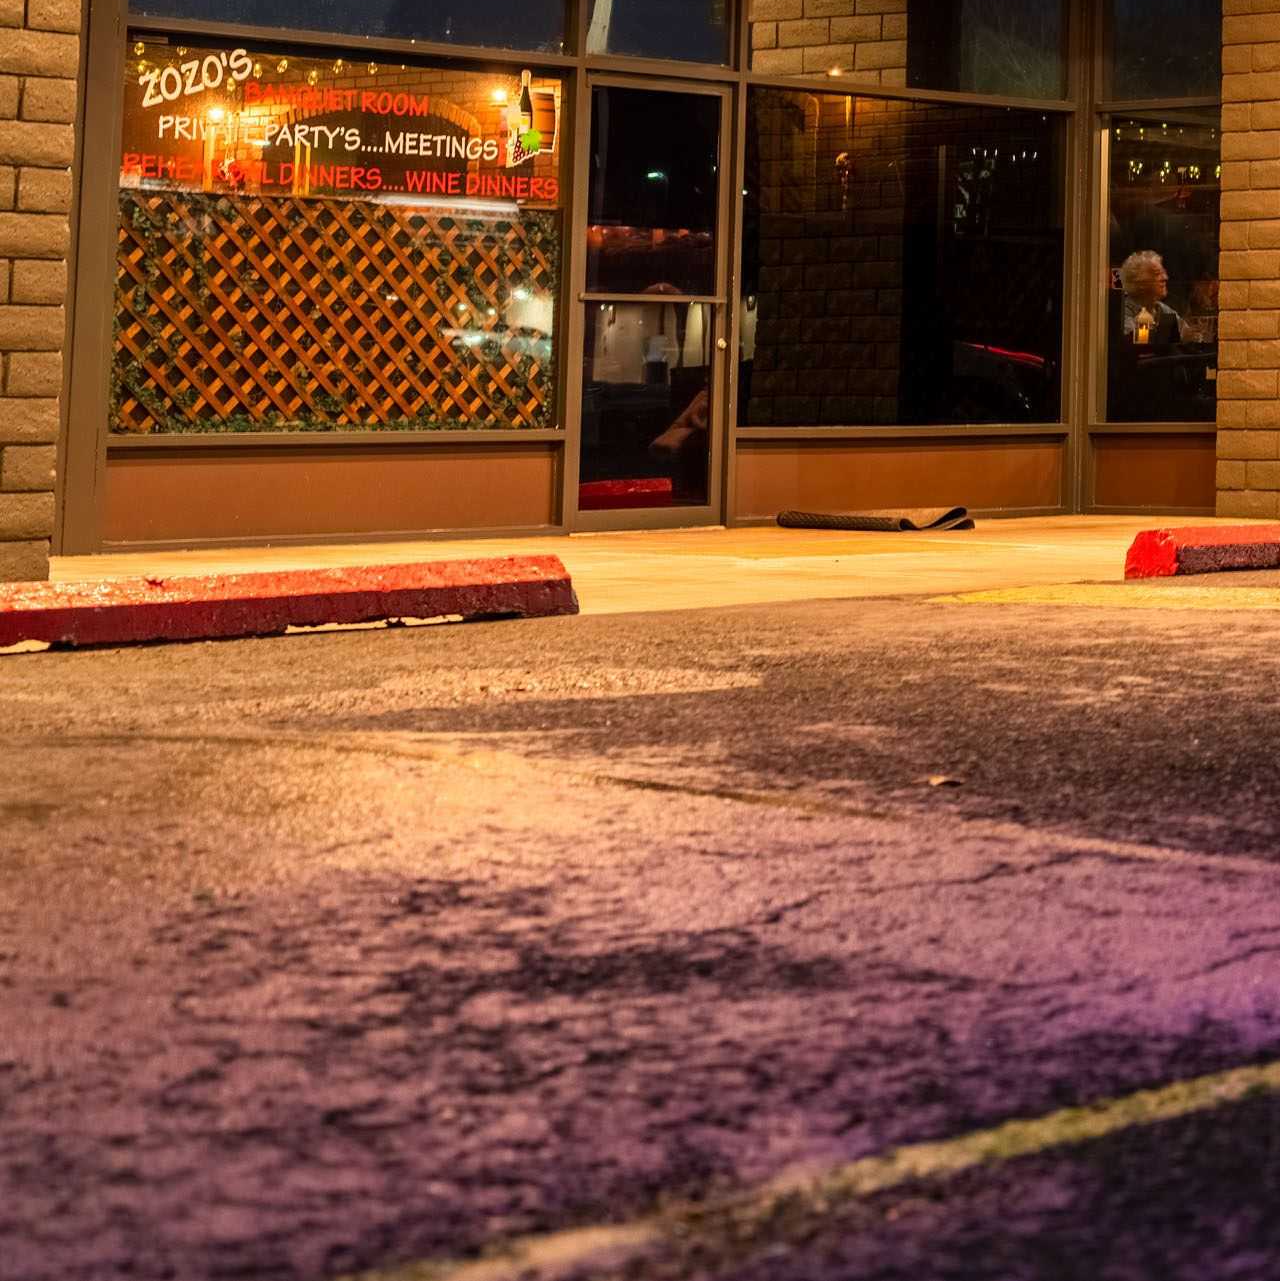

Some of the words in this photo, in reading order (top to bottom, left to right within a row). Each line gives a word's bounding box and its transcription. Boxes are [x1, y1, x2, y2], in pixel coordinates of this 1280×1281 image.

[139, 49, 253, 108] ZOZO'S
[244, 81, 358, 111] BANQUET
[361, 91, 431, 117] ROOM
[465, 173, 560, 200] DINNERS
